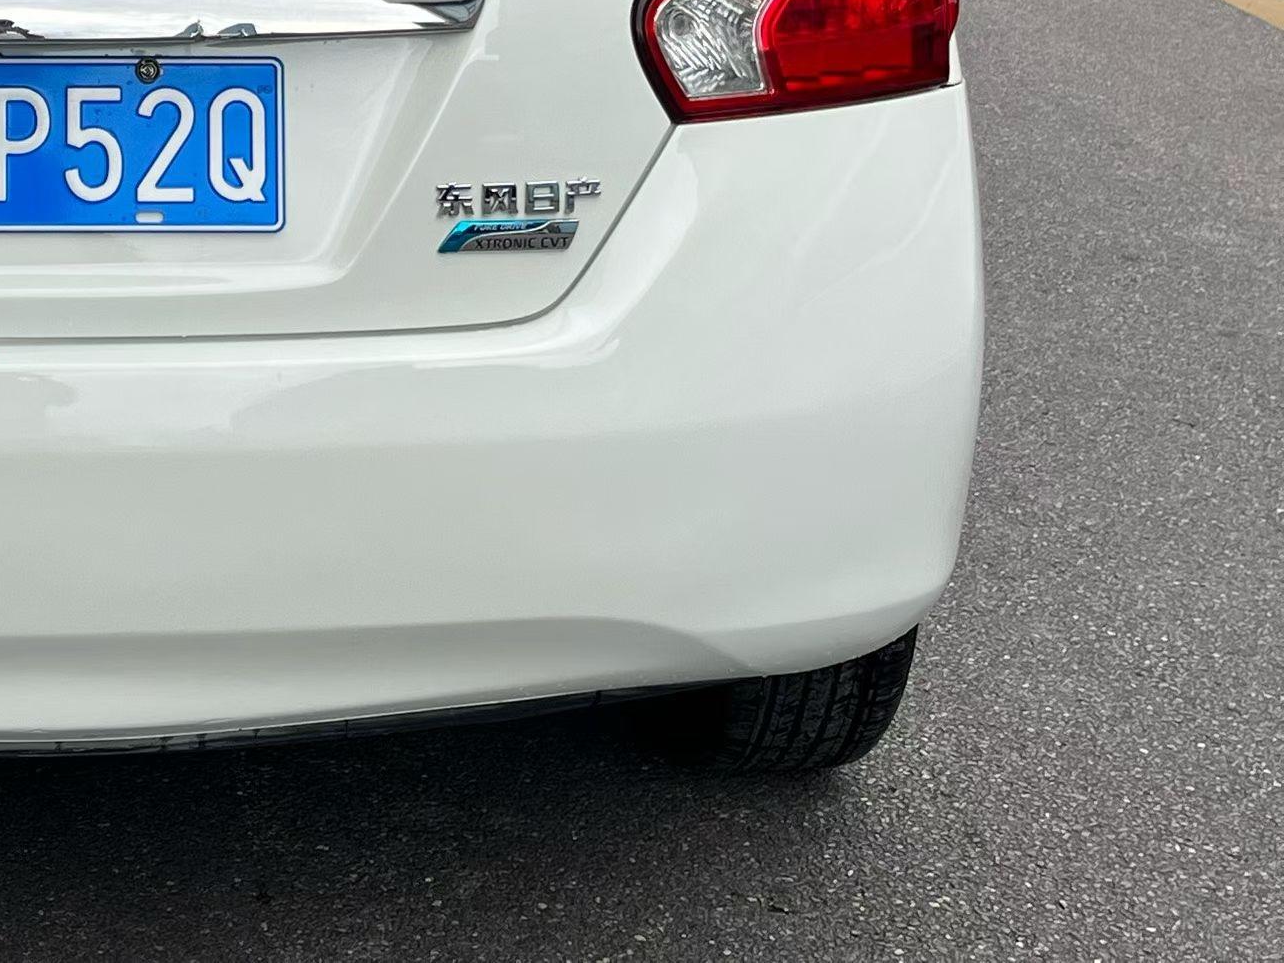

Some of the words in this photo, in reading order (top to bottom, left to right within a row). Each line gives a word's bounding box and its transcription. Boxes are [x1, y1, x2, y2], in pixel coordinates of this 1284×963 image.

[436, 176, 601, 215] 东风日产
[475, 237, 536, 249] XTRONIC
[541, 237, 569, 248] CVT
